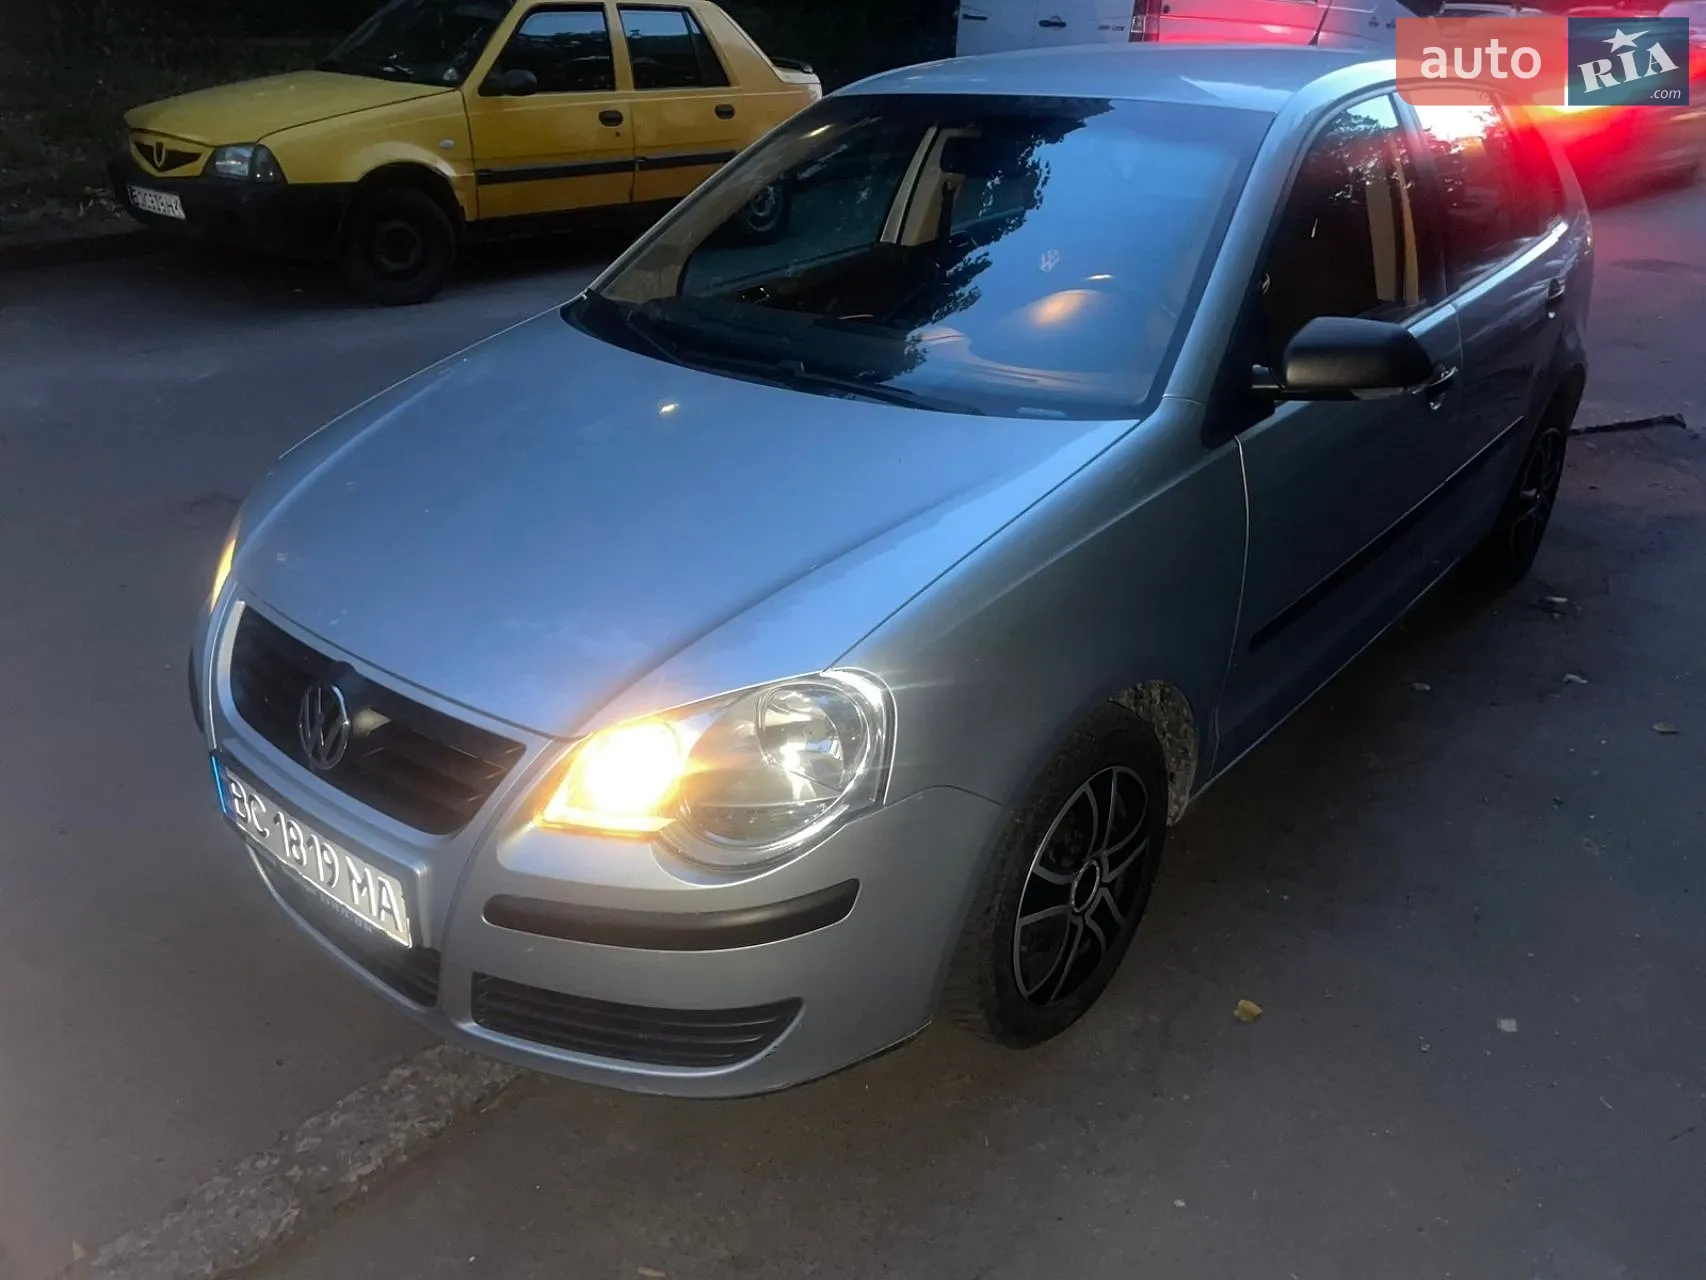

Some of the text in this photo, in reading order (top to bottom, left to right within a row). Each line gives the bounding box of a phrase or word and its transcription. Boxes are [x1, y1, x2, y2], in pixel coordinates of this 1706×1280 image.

[229, 775, 270, 839] BC
[273, 810, 340, 888] 1819
[345, 854, 404, 933] MA
